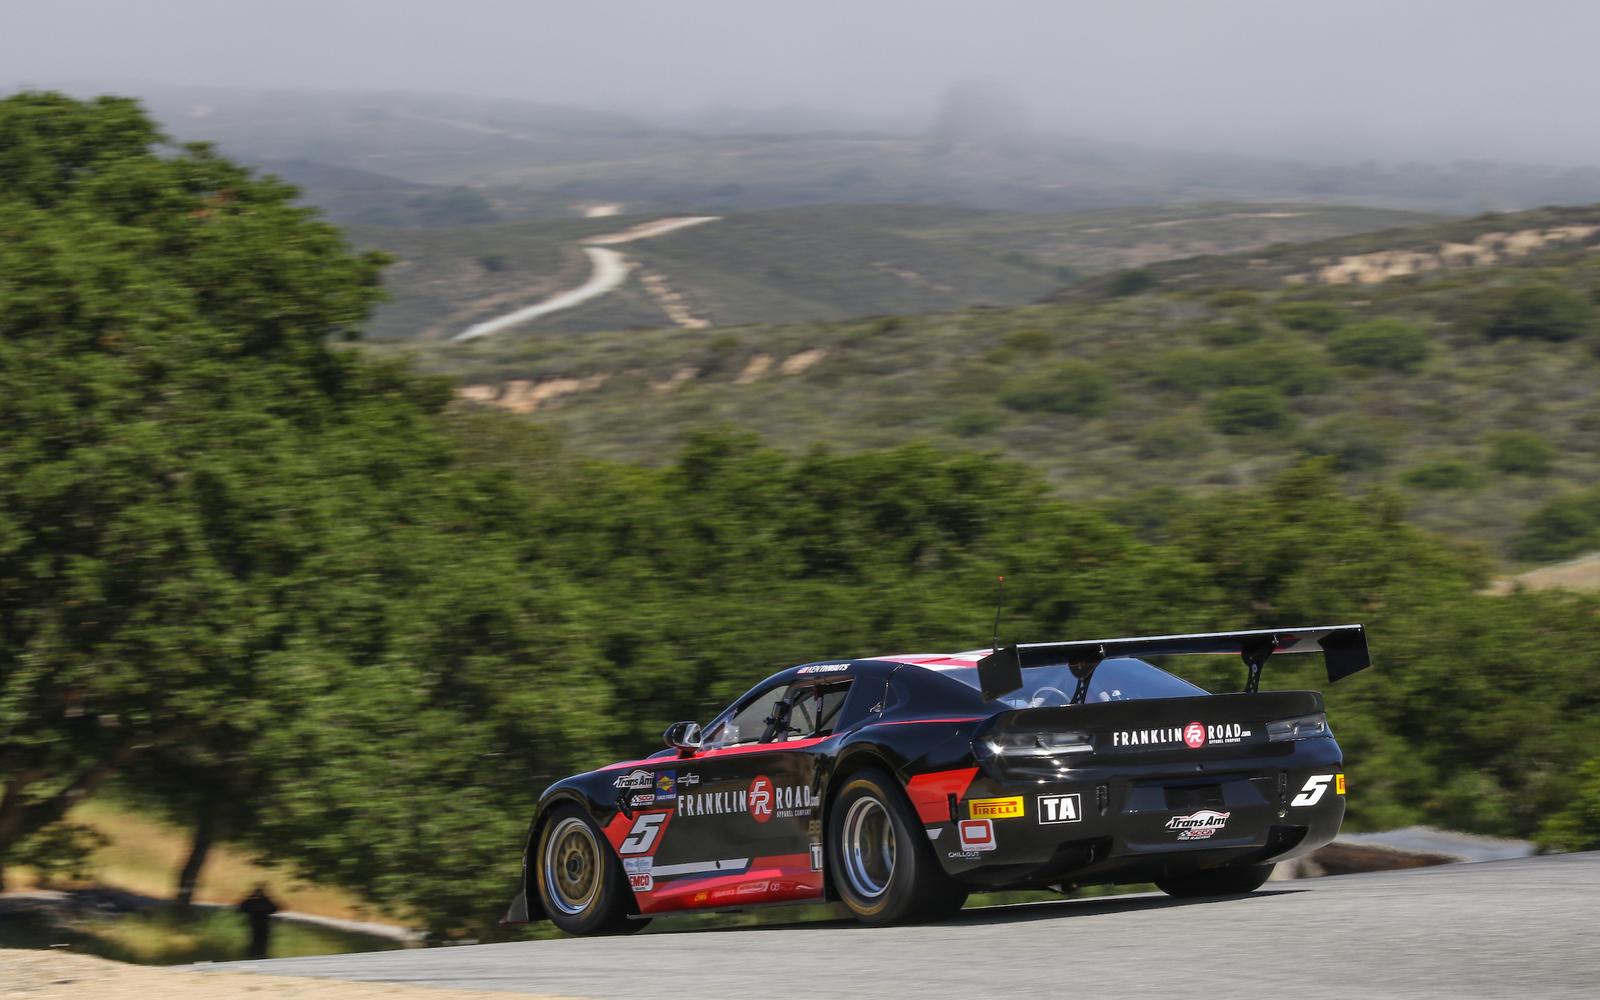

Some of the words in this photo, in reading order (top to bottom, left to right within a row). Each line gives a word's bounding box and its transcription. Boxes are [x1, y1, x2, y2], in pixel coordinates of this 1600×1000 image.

[1113, 727, 1183, 747] FRANKLIN
[617, 777, 640, 788] Trans
[640, 775, 653, 786] Am
[1290, 774, 1334, 807] 5
[678, 790, 748, 817] FRANKLIN
[972, 800, 1018, 816] PIRELLI
[1043, 797, 1077, 821] TA
[1172, 817, 1205, 828] Trans
[1204, 815, 1226, 827] Am
[620, 813, 667, 854] 5
